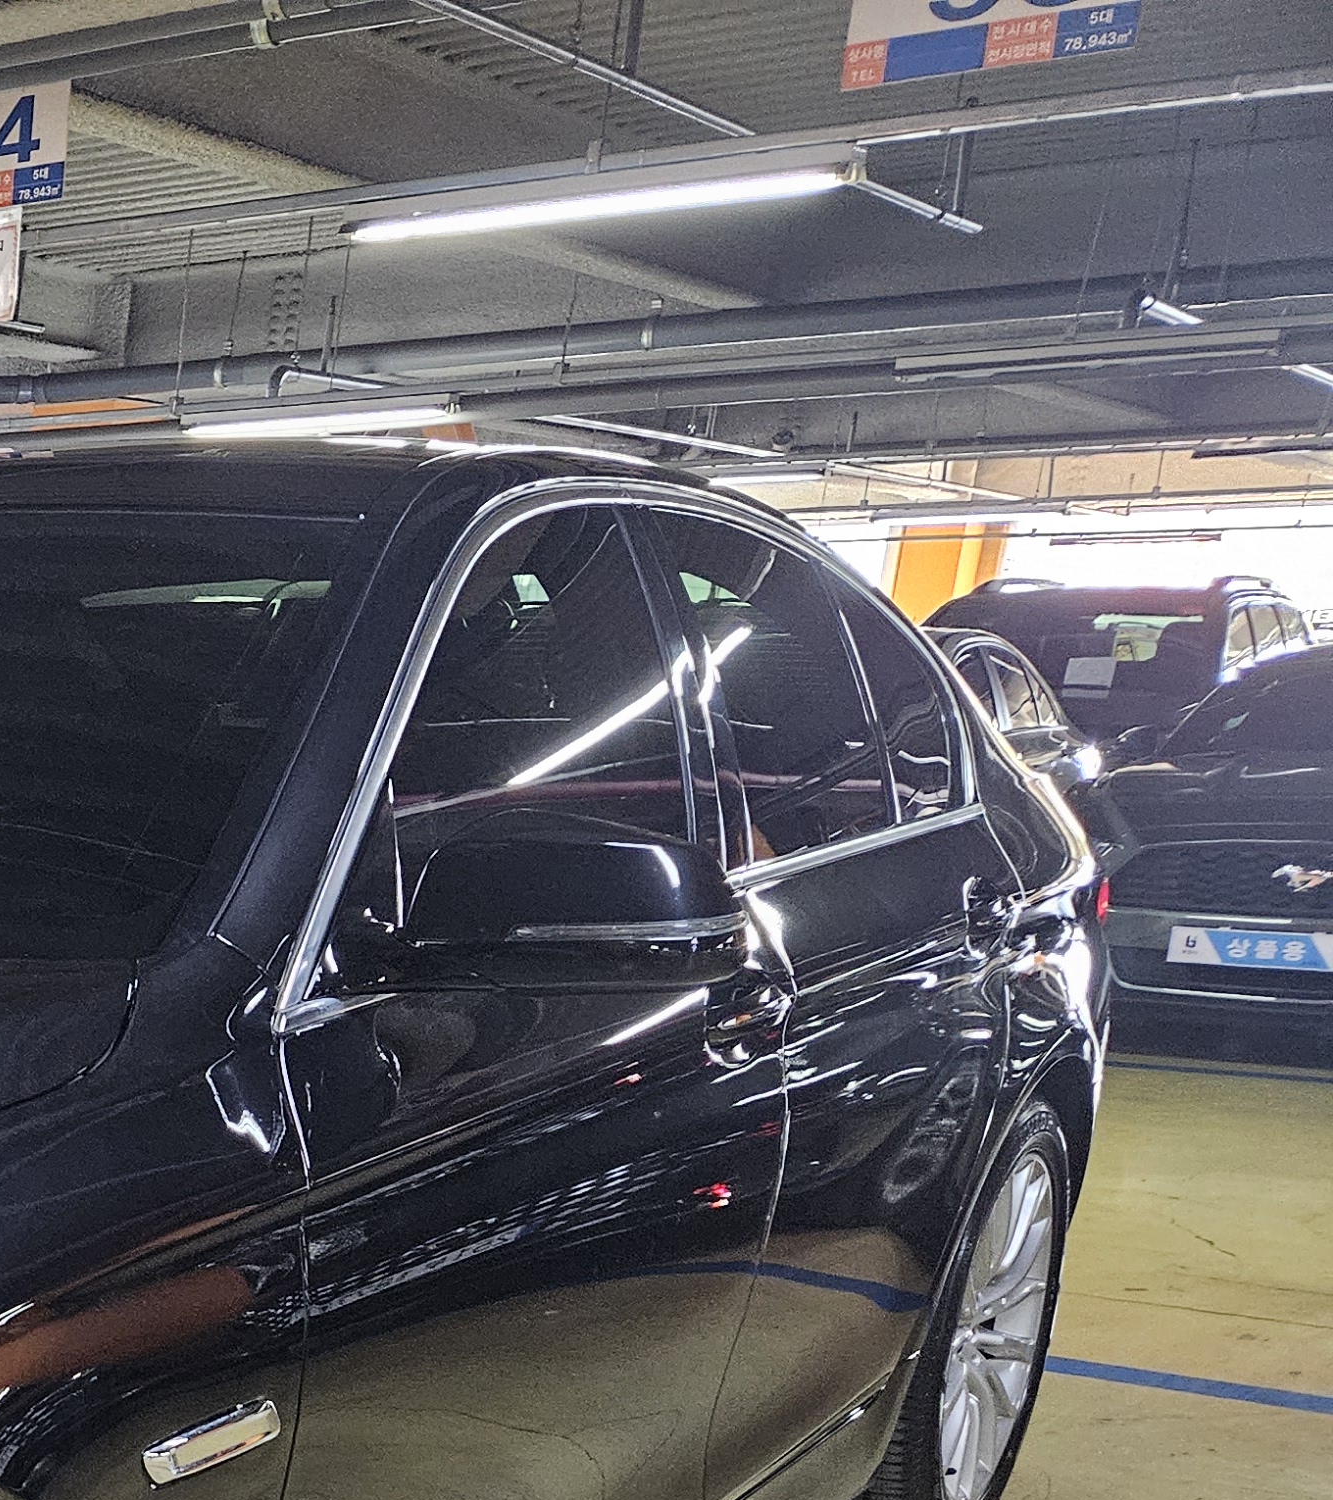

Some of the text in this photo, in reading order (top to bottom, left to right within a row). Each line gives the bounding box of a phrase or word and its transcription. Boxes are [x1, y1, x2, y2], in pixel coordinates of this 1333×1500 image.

[1089, 9, 1113, 25] 5대
[992, 18, 1054, 40] 전시대수
[850, 69, 875, 83] TEL
[32, 166, 49, 180] 5대
[1227, 937, 1307, 962] 상품용
